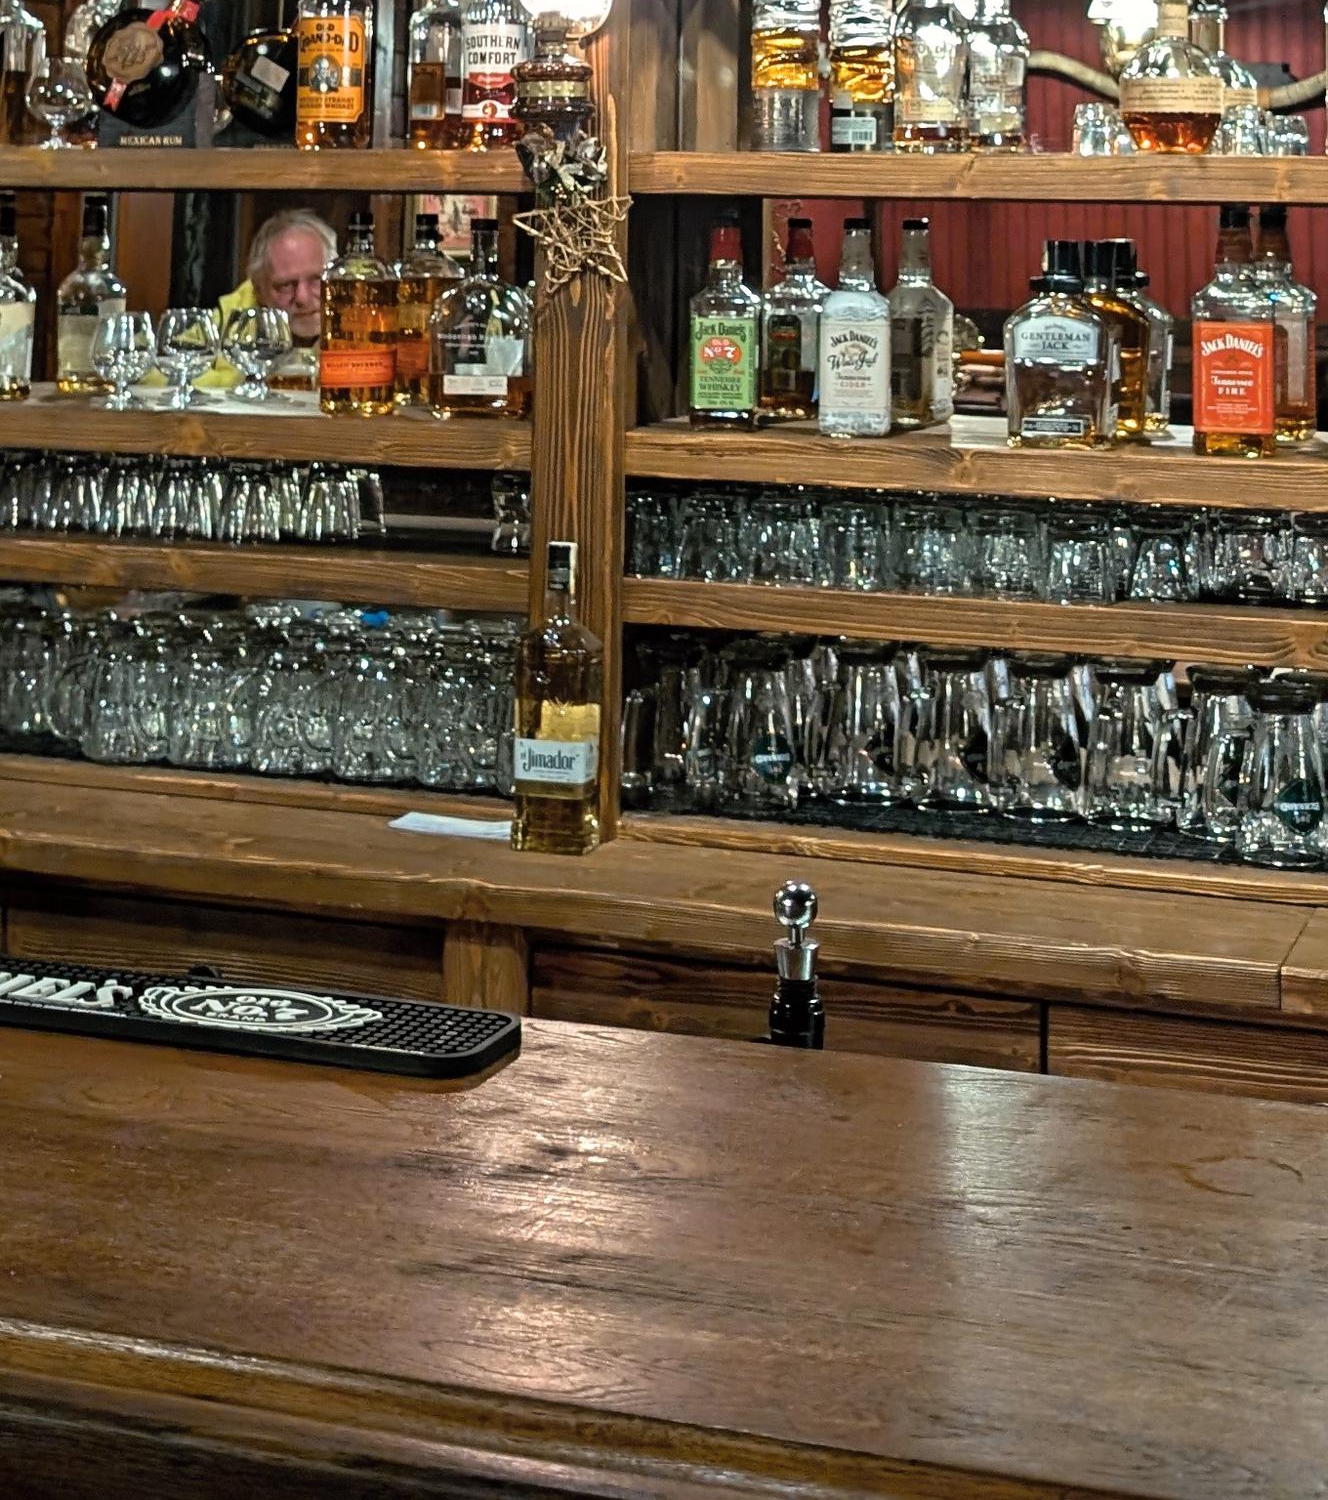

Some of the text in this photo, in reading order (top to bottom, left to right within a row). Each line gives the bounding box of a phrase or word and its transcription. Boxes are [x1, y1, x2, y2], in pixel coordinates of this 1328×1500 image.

[467, 35, 521, 50] SOUTHERN
[468, 51, 517, 65] COMFORT
[120, 135, 183, 146] MEXICAN RUM
[830, 330, 879, 349] JACK DANIEL'S
[1021, 331, 1090, 341] GENTLEMAN
[1041, 341, 1071, 350] JACK
[1200, 333, 1265, 359] JACK DANIEL'S
[1211, 375, 1254, 387] Tennessee
[1217, 387, 1246, 396] FIRE
[522, 747, 576, 772] Jimador
